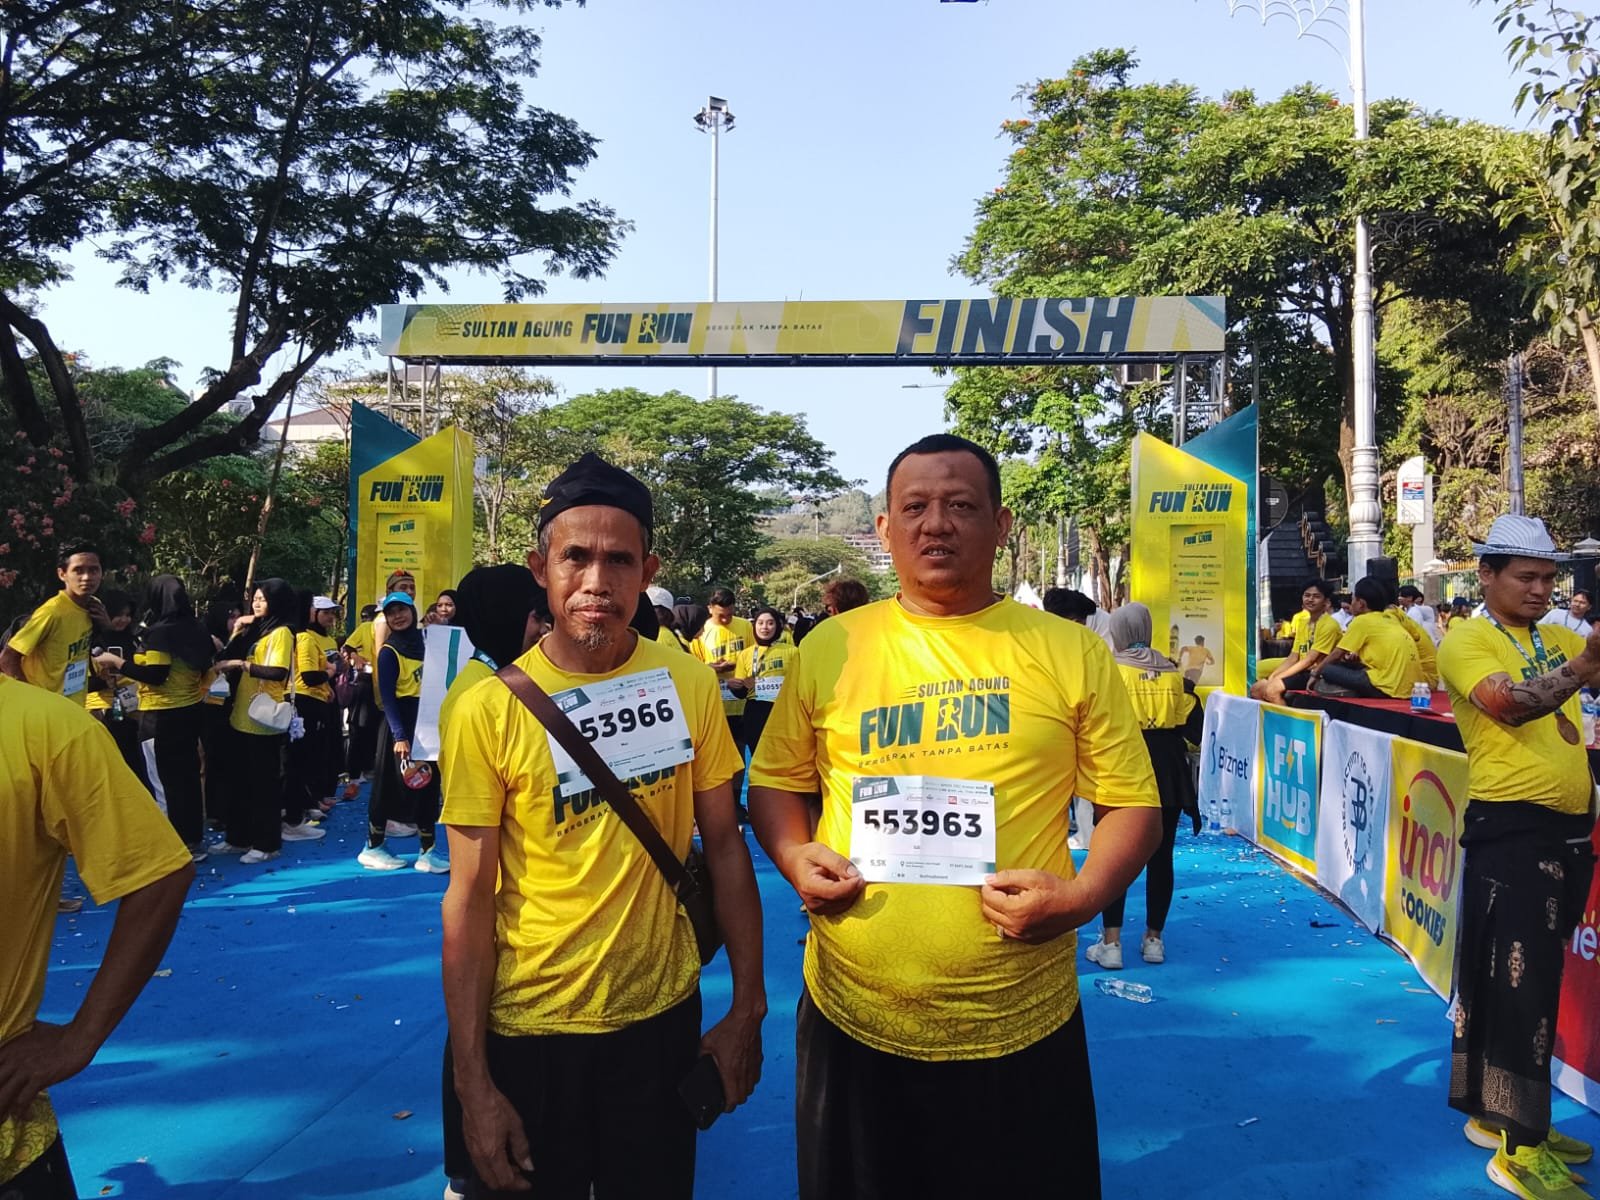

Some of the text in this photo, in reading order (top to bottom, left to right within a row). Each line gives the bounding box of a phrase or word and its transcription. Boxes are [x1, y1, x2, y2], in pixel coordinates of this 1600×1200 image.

[463, 313, 693, 344] SULTAN AGUNG FUN RUN
[896, 297, 1136, 352] FINISH
[370, 481, 444, 502] FUN RUN
[1149, 490, 1232, 513] FUN RUN
[918, 676, 1010, 698] SULTAN AGUNG
[579, 699, 674, 743] 53966
[860, 693, 1010, 756] FUN RUN
[922, 746, 962, 757] TANPA
[969, 742, 1010, 752] BATAS
[1218, 746, 1248, 780] Biznet
[552, 783, 606, 825] FU
[1266, 776, 1311, 836] HUB
[556, 806, 609, 837] BERGERAK
[864, 809, 982, 838] 553963
[1401, 887, 1447, 948] COOKIES
